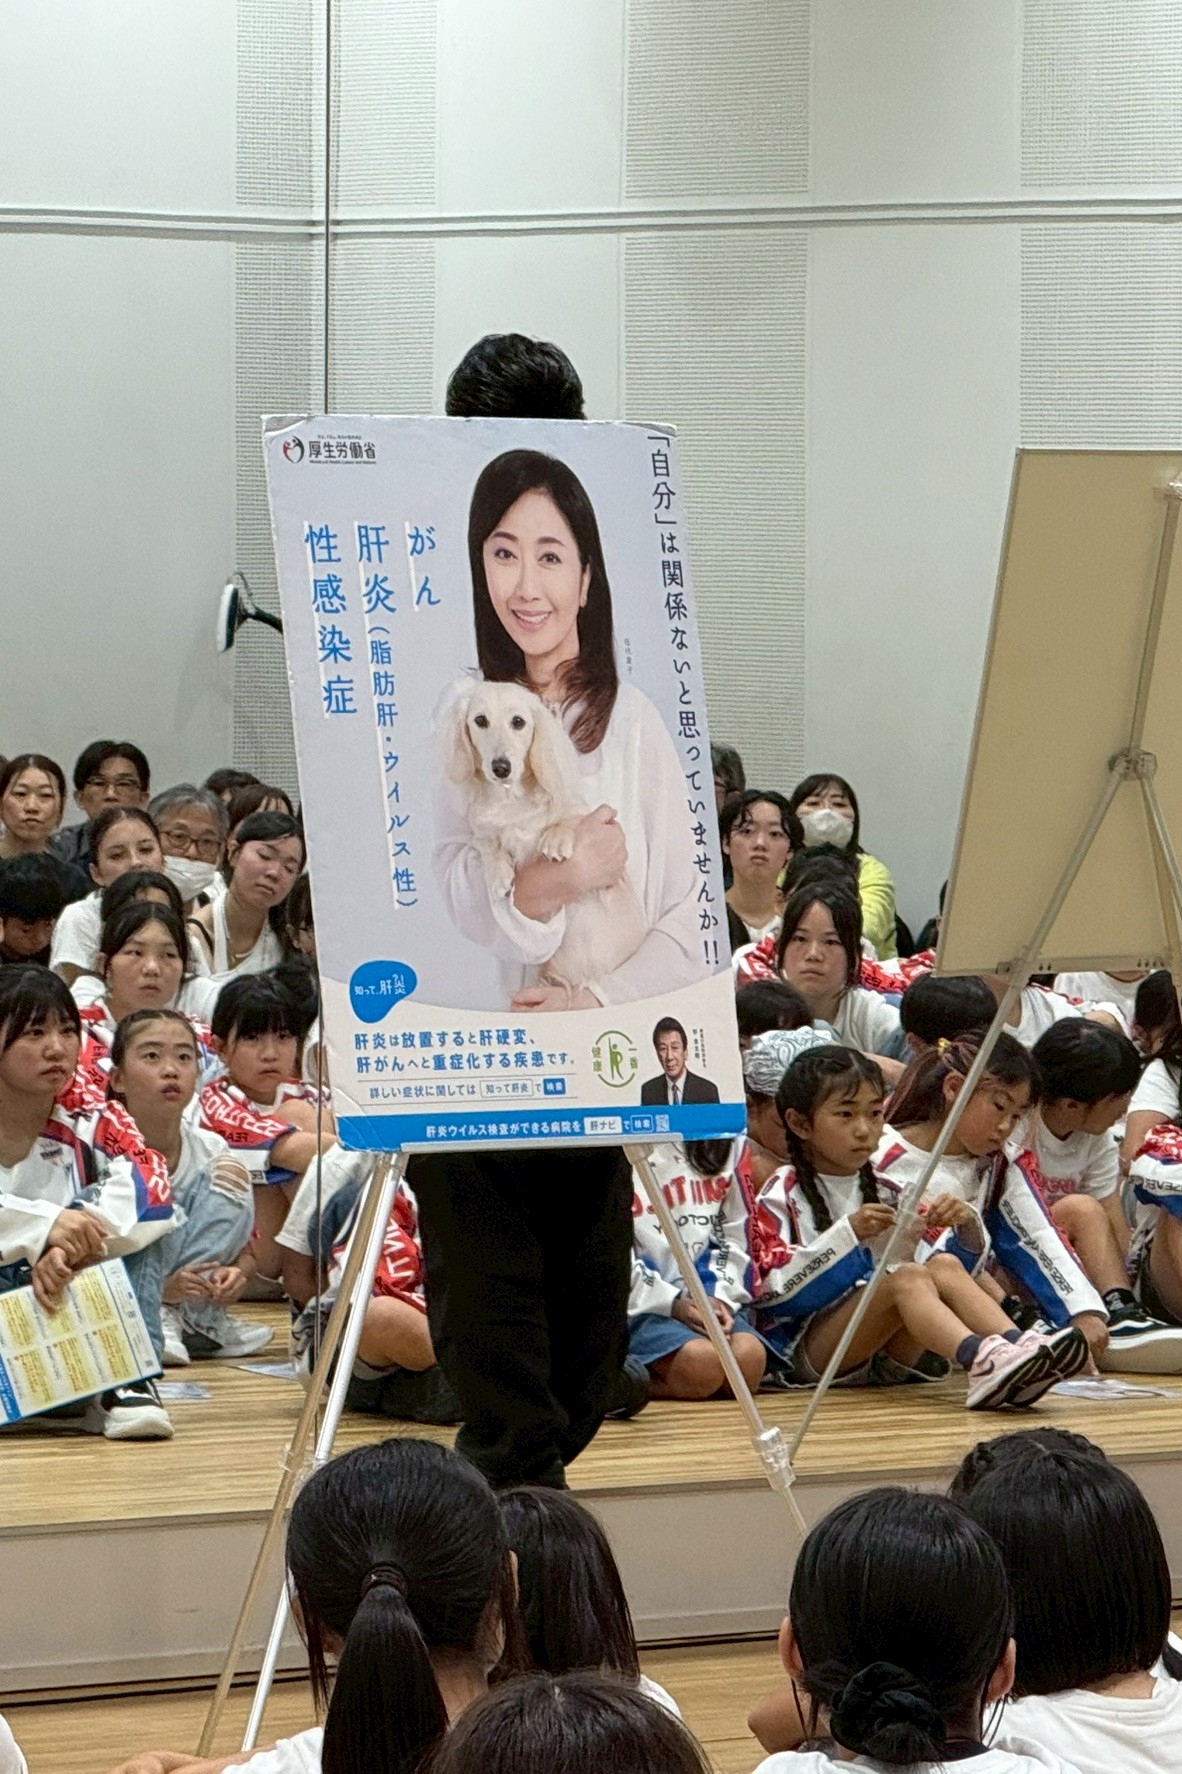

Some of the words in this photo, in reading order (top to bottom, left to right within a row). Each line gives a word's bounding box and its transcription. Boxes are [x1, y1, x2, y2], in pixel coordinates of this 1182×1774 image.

[308, 440, 377, 459] 厚生労働省
[407, 525, 441, 606] がん
[304, 523, 358, 715] 性感染症
